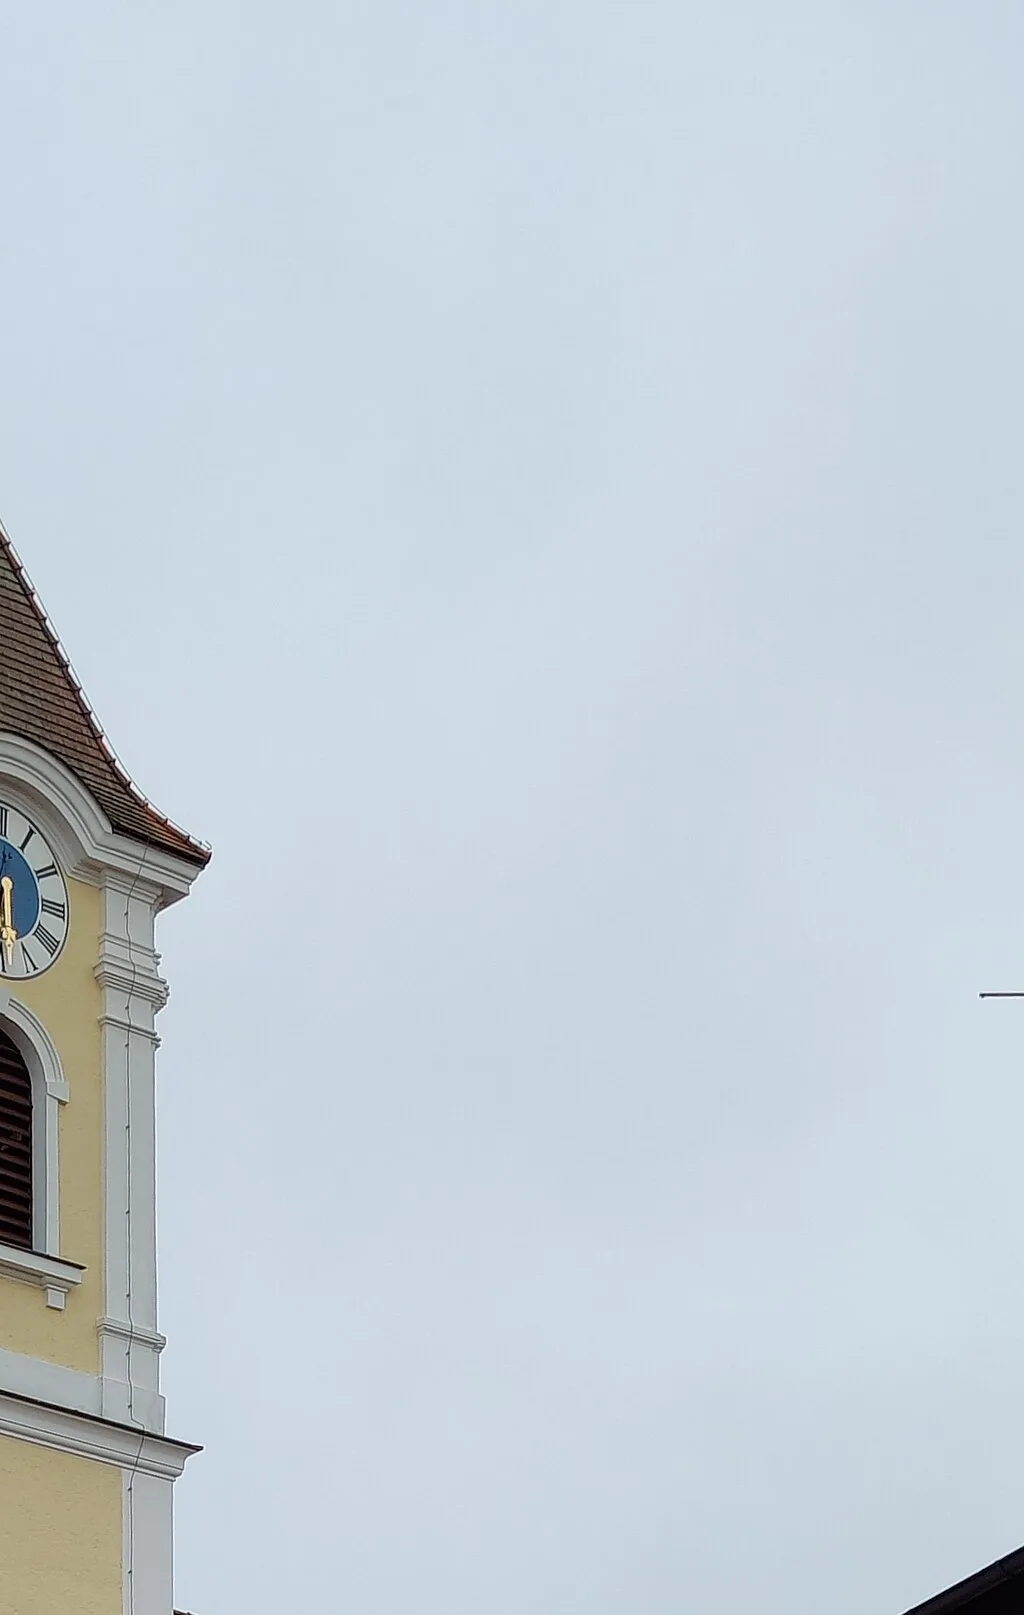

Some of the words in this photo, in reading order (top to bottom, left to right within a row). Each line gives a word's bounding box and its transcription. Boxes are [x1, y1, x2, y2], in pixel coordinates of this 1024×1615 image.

[18, 825, 36, 853] I
[33, 861, 59, 883] II
[41, 895, 65, 922] III
[32, 920, 61, 958] IIII
[20, 941, 39, 974] V
